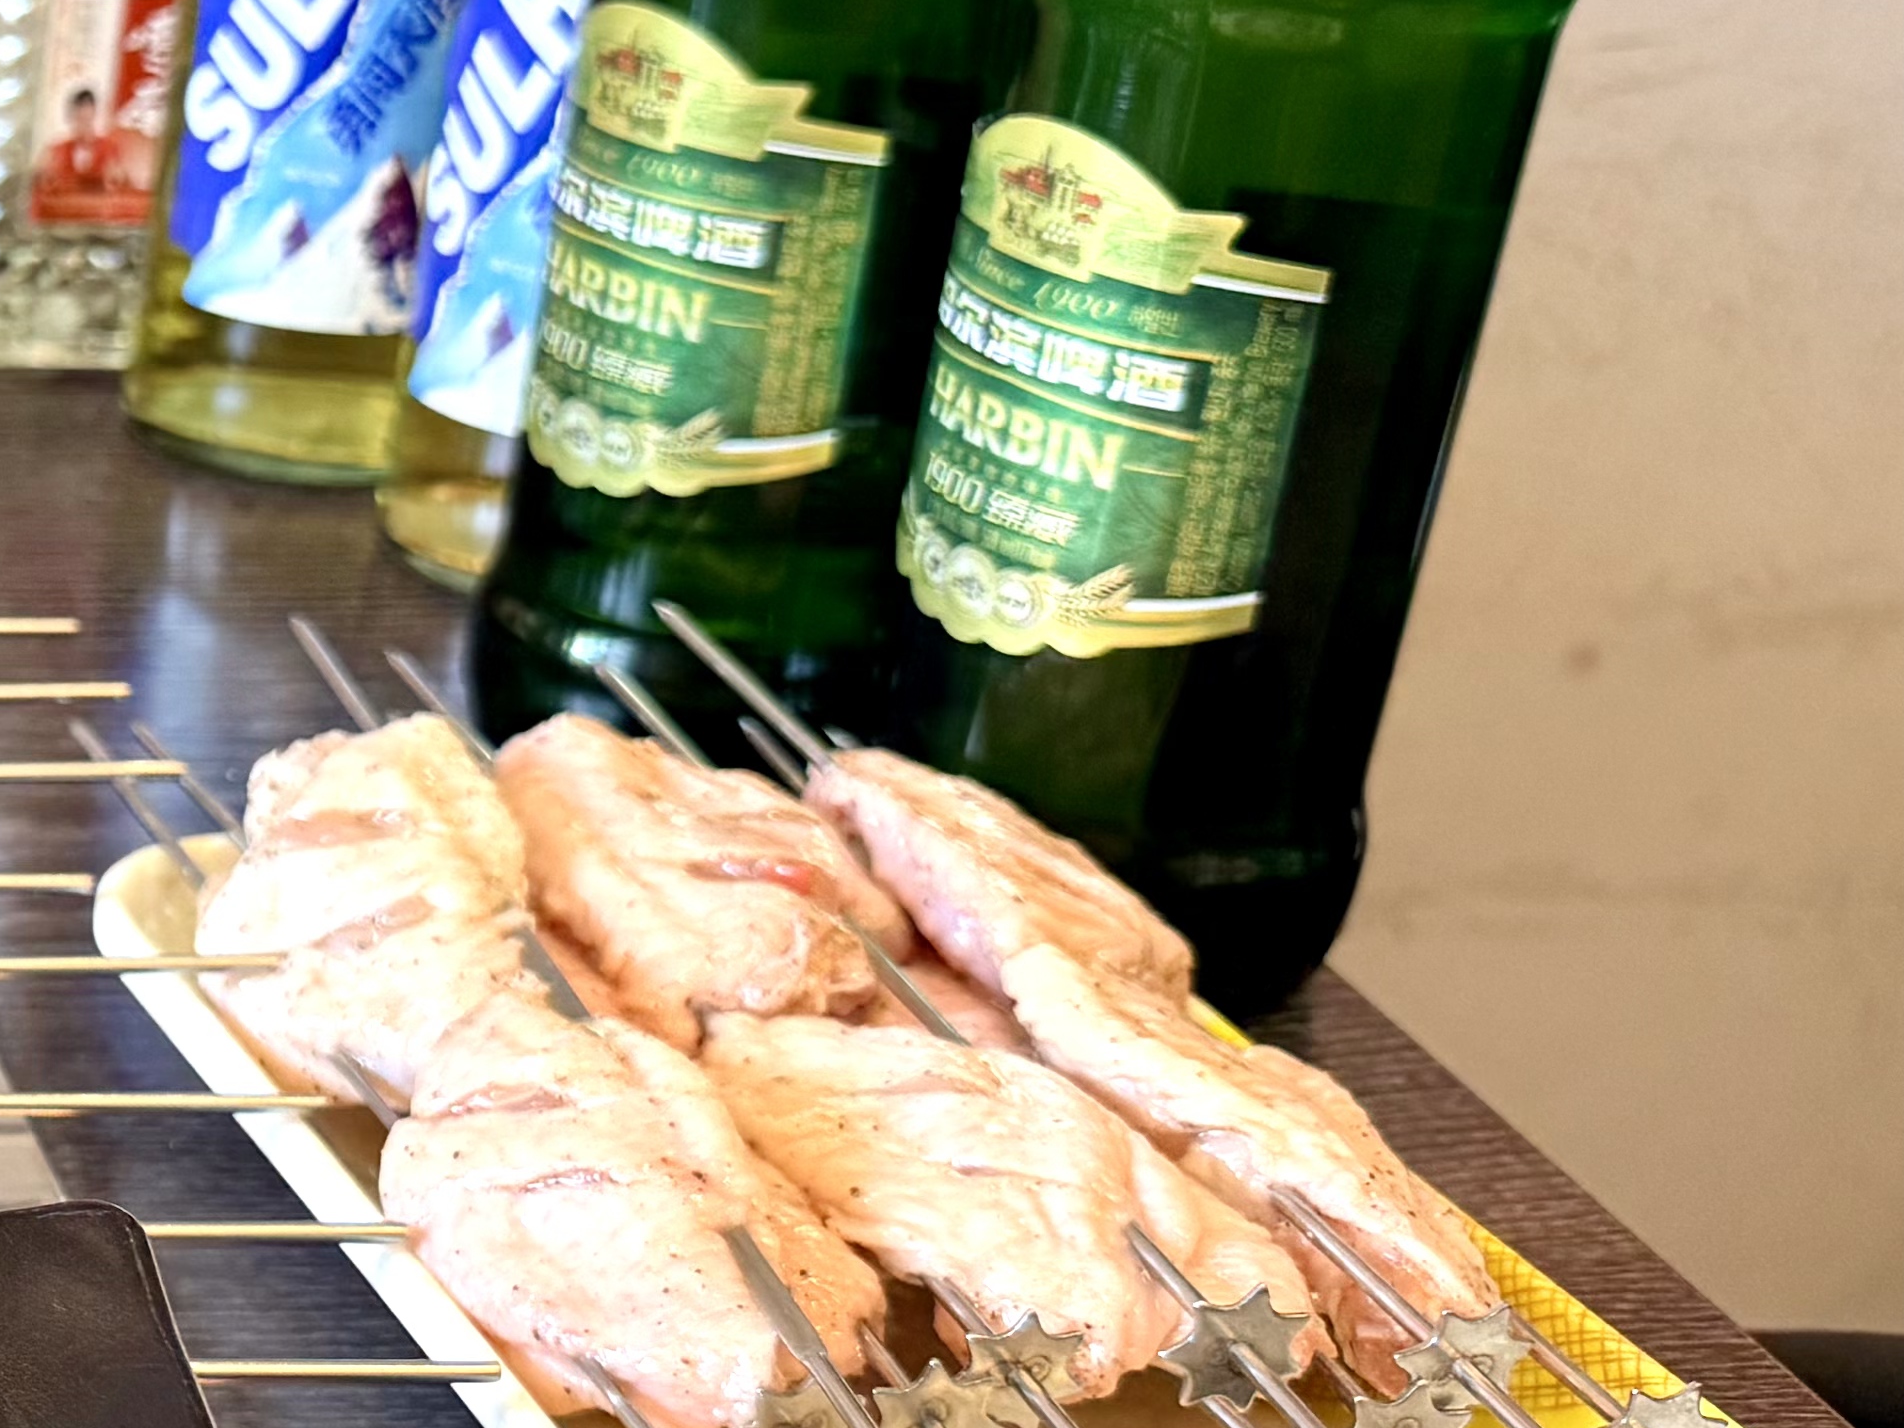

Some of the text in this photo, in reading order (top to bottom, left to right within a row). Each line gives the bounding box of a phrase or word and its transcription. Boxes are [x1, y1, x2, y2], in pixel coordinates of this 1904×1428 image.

[550, 168, 774, 270] 尔滨啤酒
[1032, 278, 1121, 321] 1900
[929, 363, 1130, 493] HARBIN
[923, 450, 986, 516] 1900
